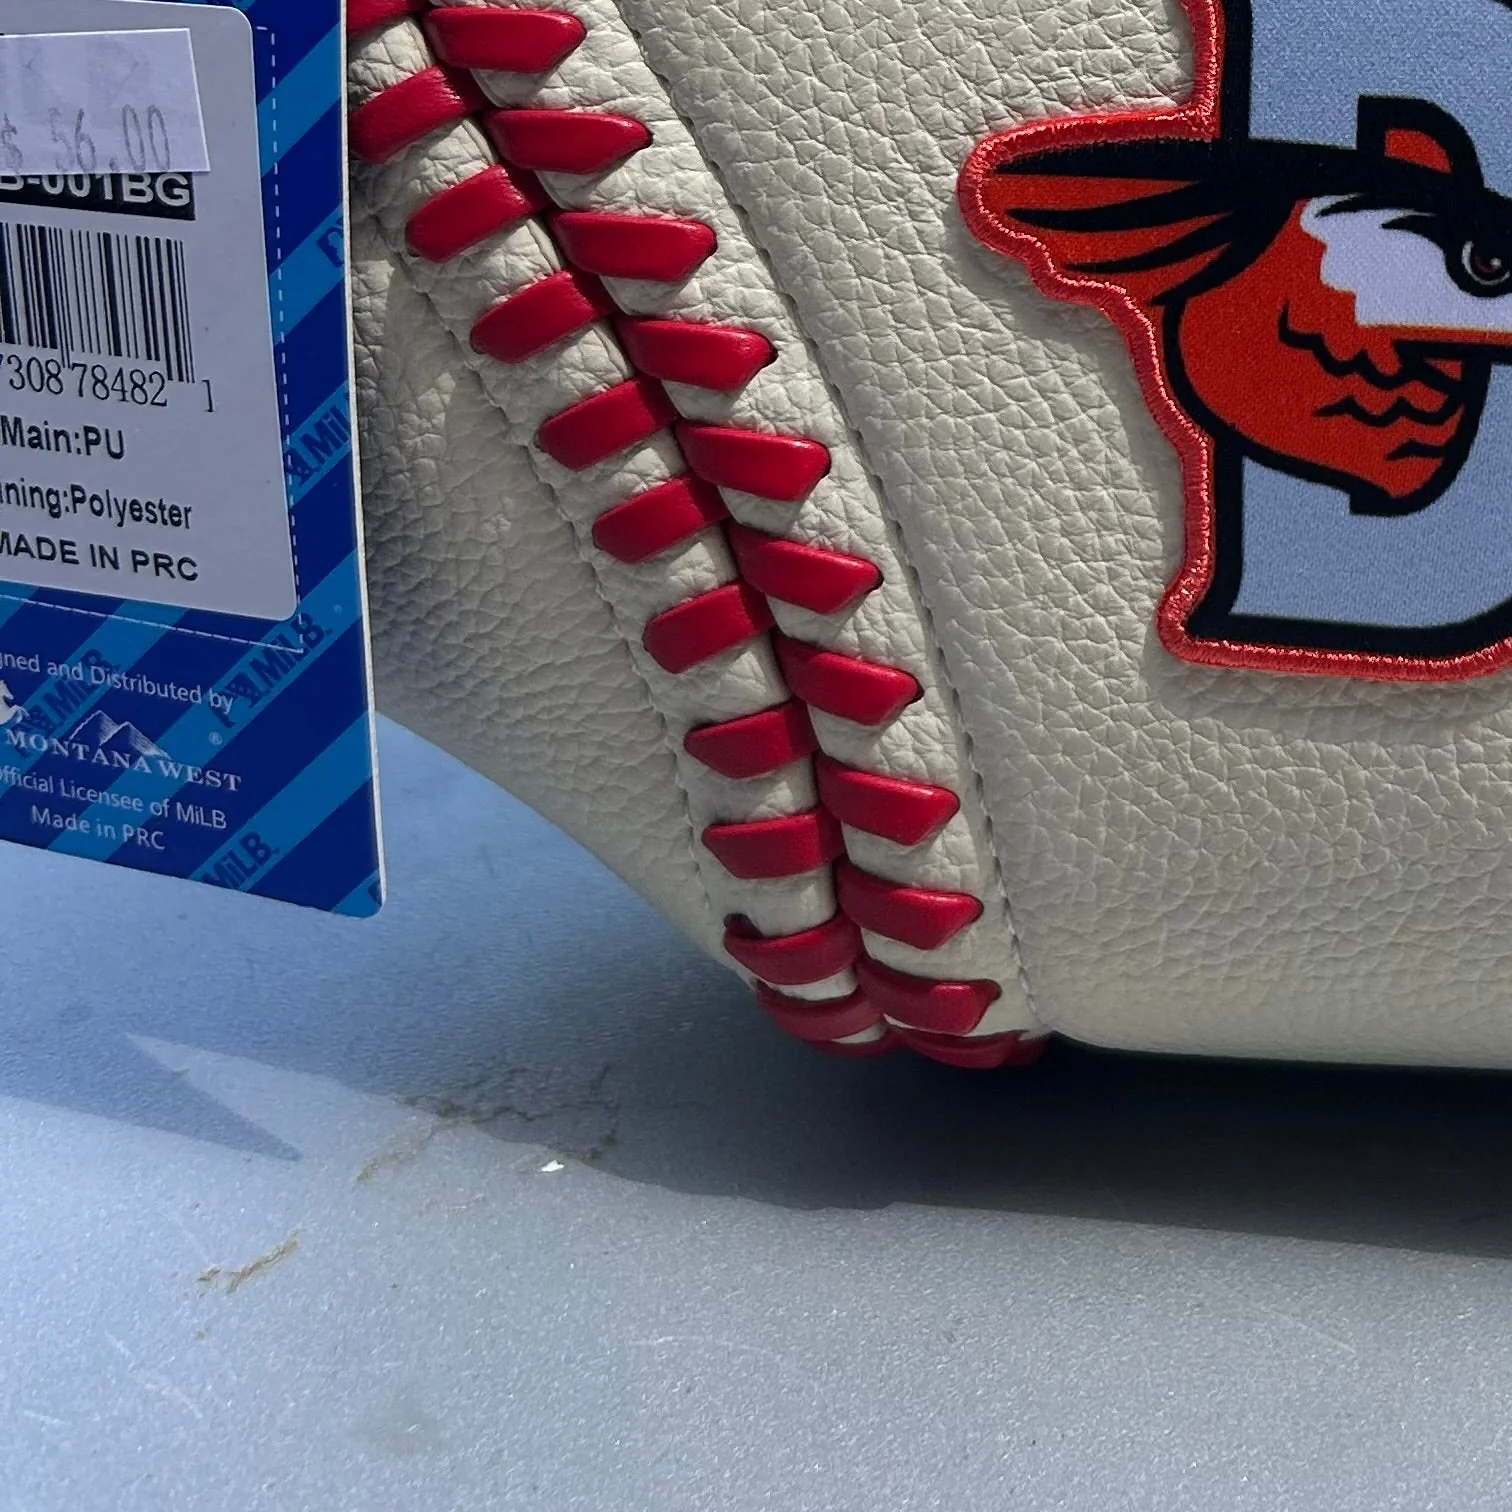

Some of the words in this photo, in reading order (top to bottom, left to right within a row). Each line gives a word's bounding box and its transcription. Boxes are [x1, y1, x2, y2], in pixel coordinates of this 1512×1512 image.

[0, 353, 64, 396] 308
[0, 414, 125, 460] Main:PU
[89, 543, 120, 571] IN
[131, 549, 199, 582] PRC
[0, 652, 41, 674] ned
[47, 661, 84, 682] and
[91, 665, 203, 706] Distributed
[208, 688, 235, 715] by
[5, 728, 153, 774] MONTANA
[157, 758, 242, 792] WEST
[31, 804, 91, 834] Made
[96, 818, 117, 840] in
[122, 823, 166, 851] PRC
[60, 778, 145, 813] Licensee
[150, 797, 171, 818] of
[176, 801, 228, 830] MiLB
